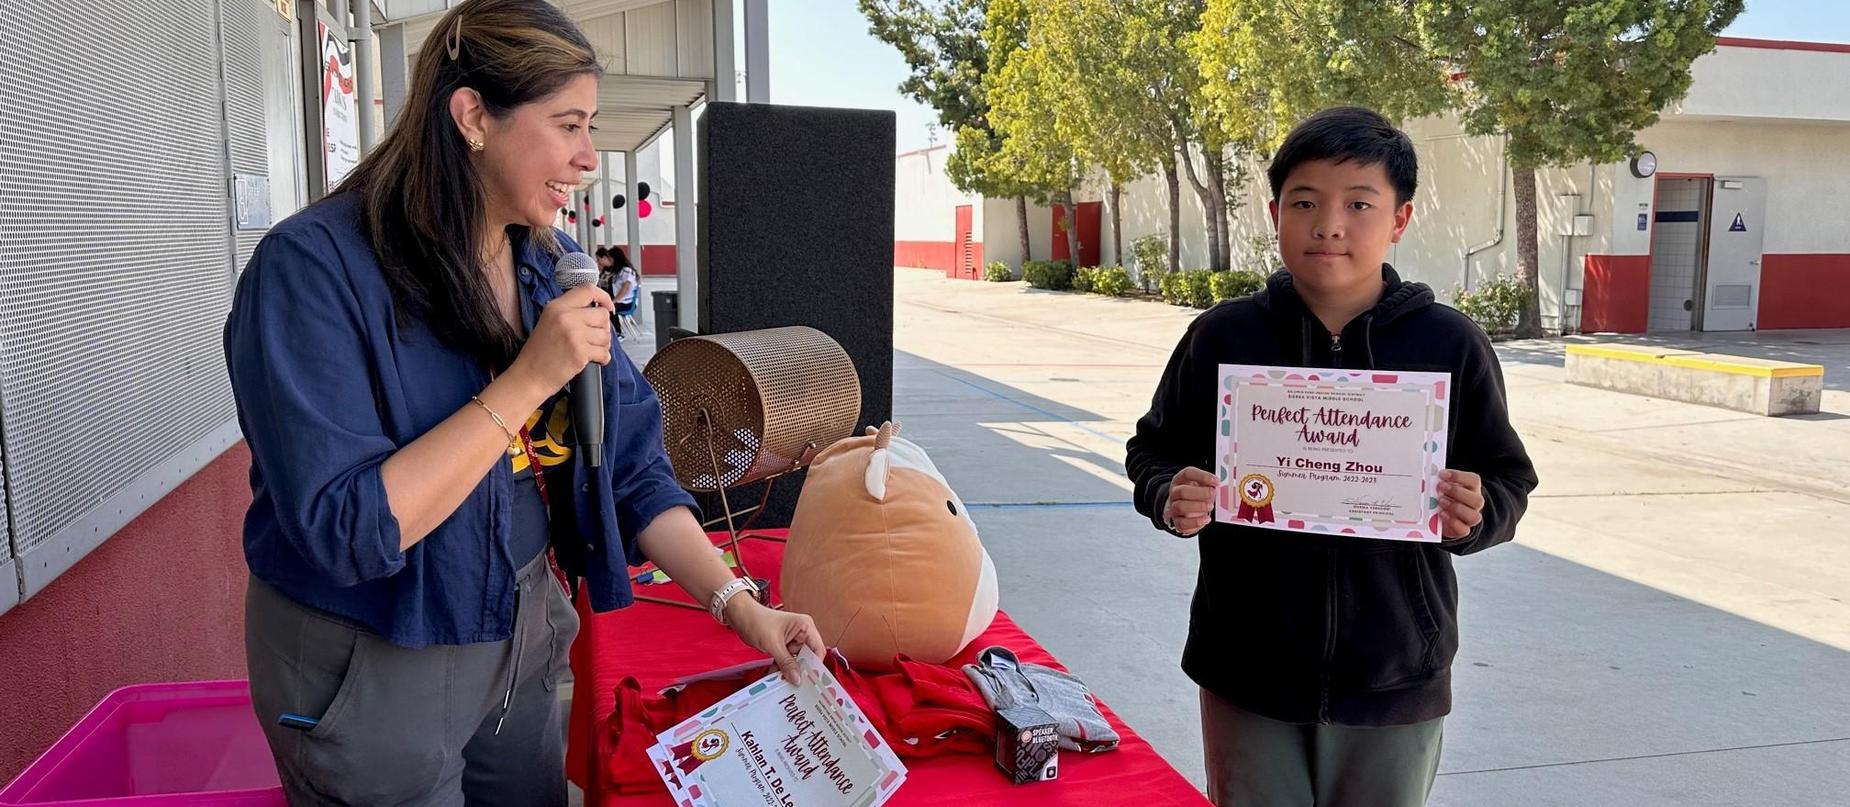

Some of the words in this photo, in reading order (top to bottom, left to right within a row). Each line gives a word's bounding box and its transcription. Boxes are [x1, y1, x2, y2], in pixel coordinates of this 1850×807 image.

[1252, 404, 1310, 425] Perfect
[1312, 407, 1412, 429] Attendance
[1296, 424, 1360, 447] Award
[1276, 456, 1291, 467] Yi
[1295, 458, 1341, 473] Cheng
[1345, 461, 1383, 473] Zhou
[1277, 470, 1307, 479] Summer
[1343, 475, 1377, 483] 2022-2023
[778, 693, 815, 736] Perfect
[805, 730, 853, 795] Attendance
[1032, 735, 1058, 744] BLUETOOTH
[736, 747, 752, 770] Summer
[741, 730, 767, 768] Kahlan
[765, 766, 776, 779] T.
[771, 777, 784, 795] De
[781, 733, 819, 781] Award
